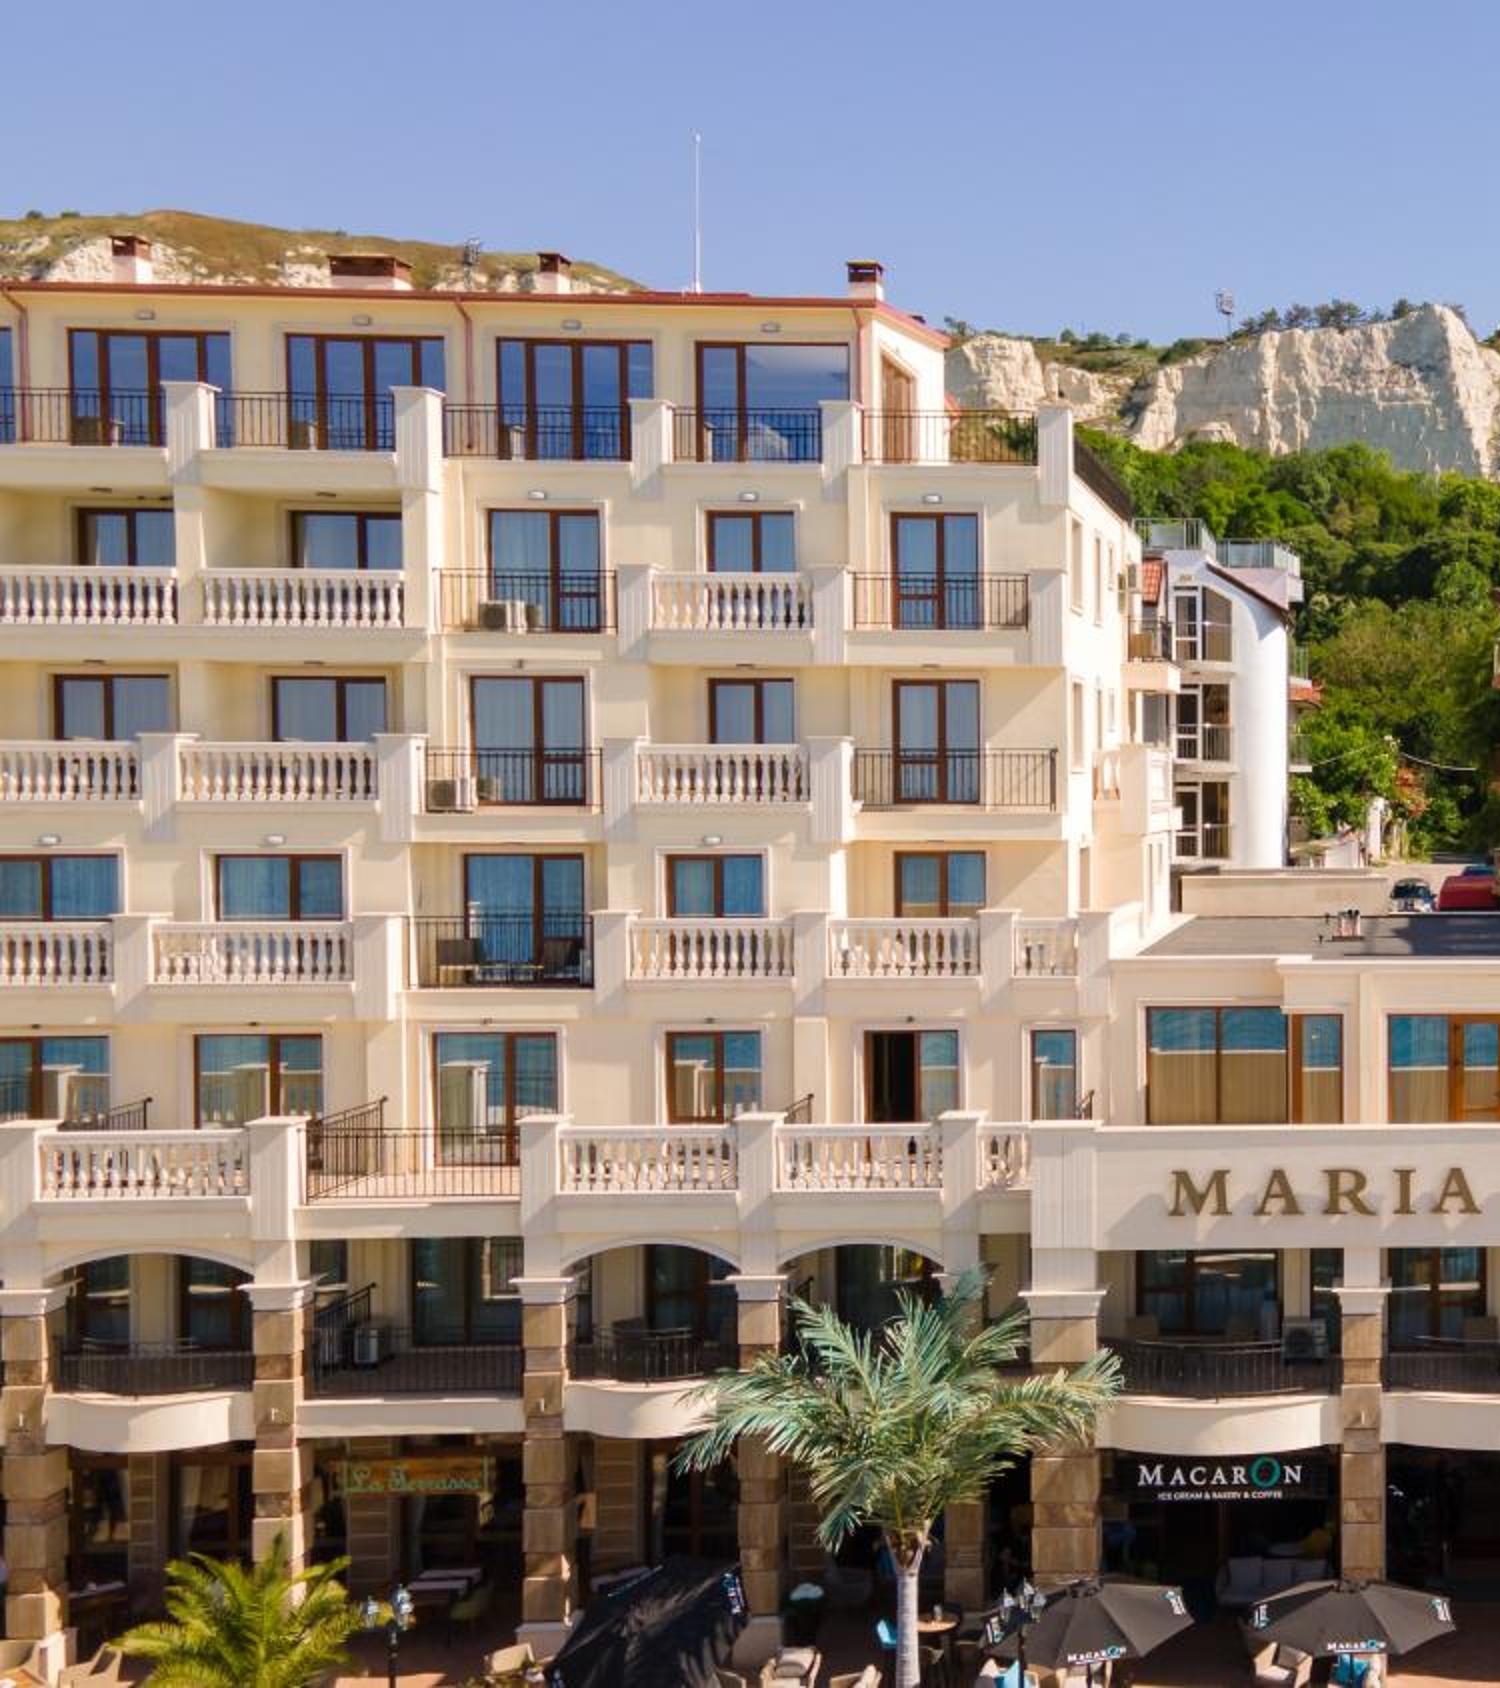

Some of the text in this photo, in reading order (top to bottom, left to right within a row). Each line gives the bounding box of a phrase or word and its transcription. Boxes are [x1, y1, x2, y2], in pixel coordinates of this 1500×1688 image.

[1168, 1167, 1483, 1217] MARIA
[1137, 1456, 1303, 1488] MACARON
[1158, 1491, 1173, 1500] ICE
[1173, 1491, 1203, 1500] CREAM
